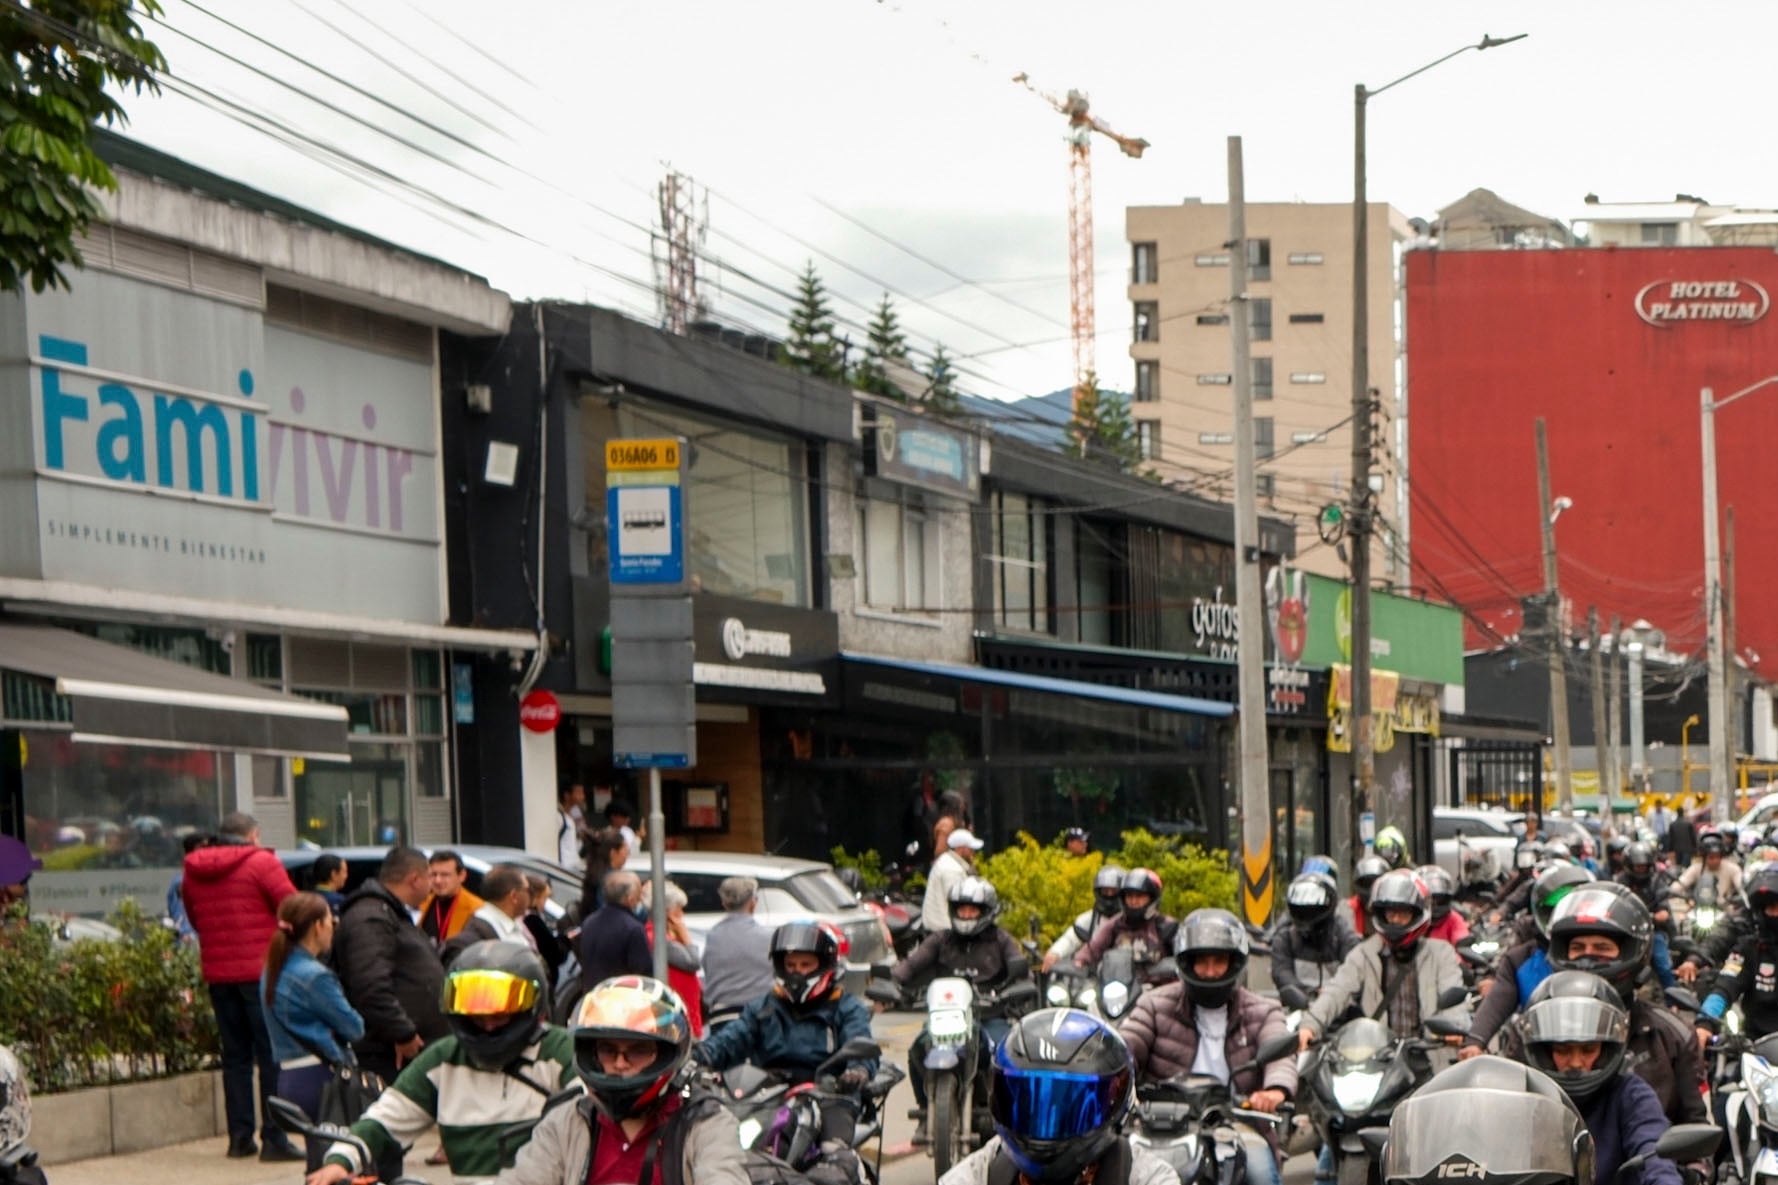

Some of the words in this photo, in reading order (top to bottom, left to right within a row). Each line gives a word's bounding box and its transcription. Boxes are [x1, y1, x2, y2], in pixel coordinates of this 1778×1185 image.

[1670, 281, 1741, 299] HOTEL
[1650, 302, 1757, 320] PLATINUM
[48, 519, 170, 553] SIMPLEMENTE
[180, 539, 267, 565] BIENESTAR
